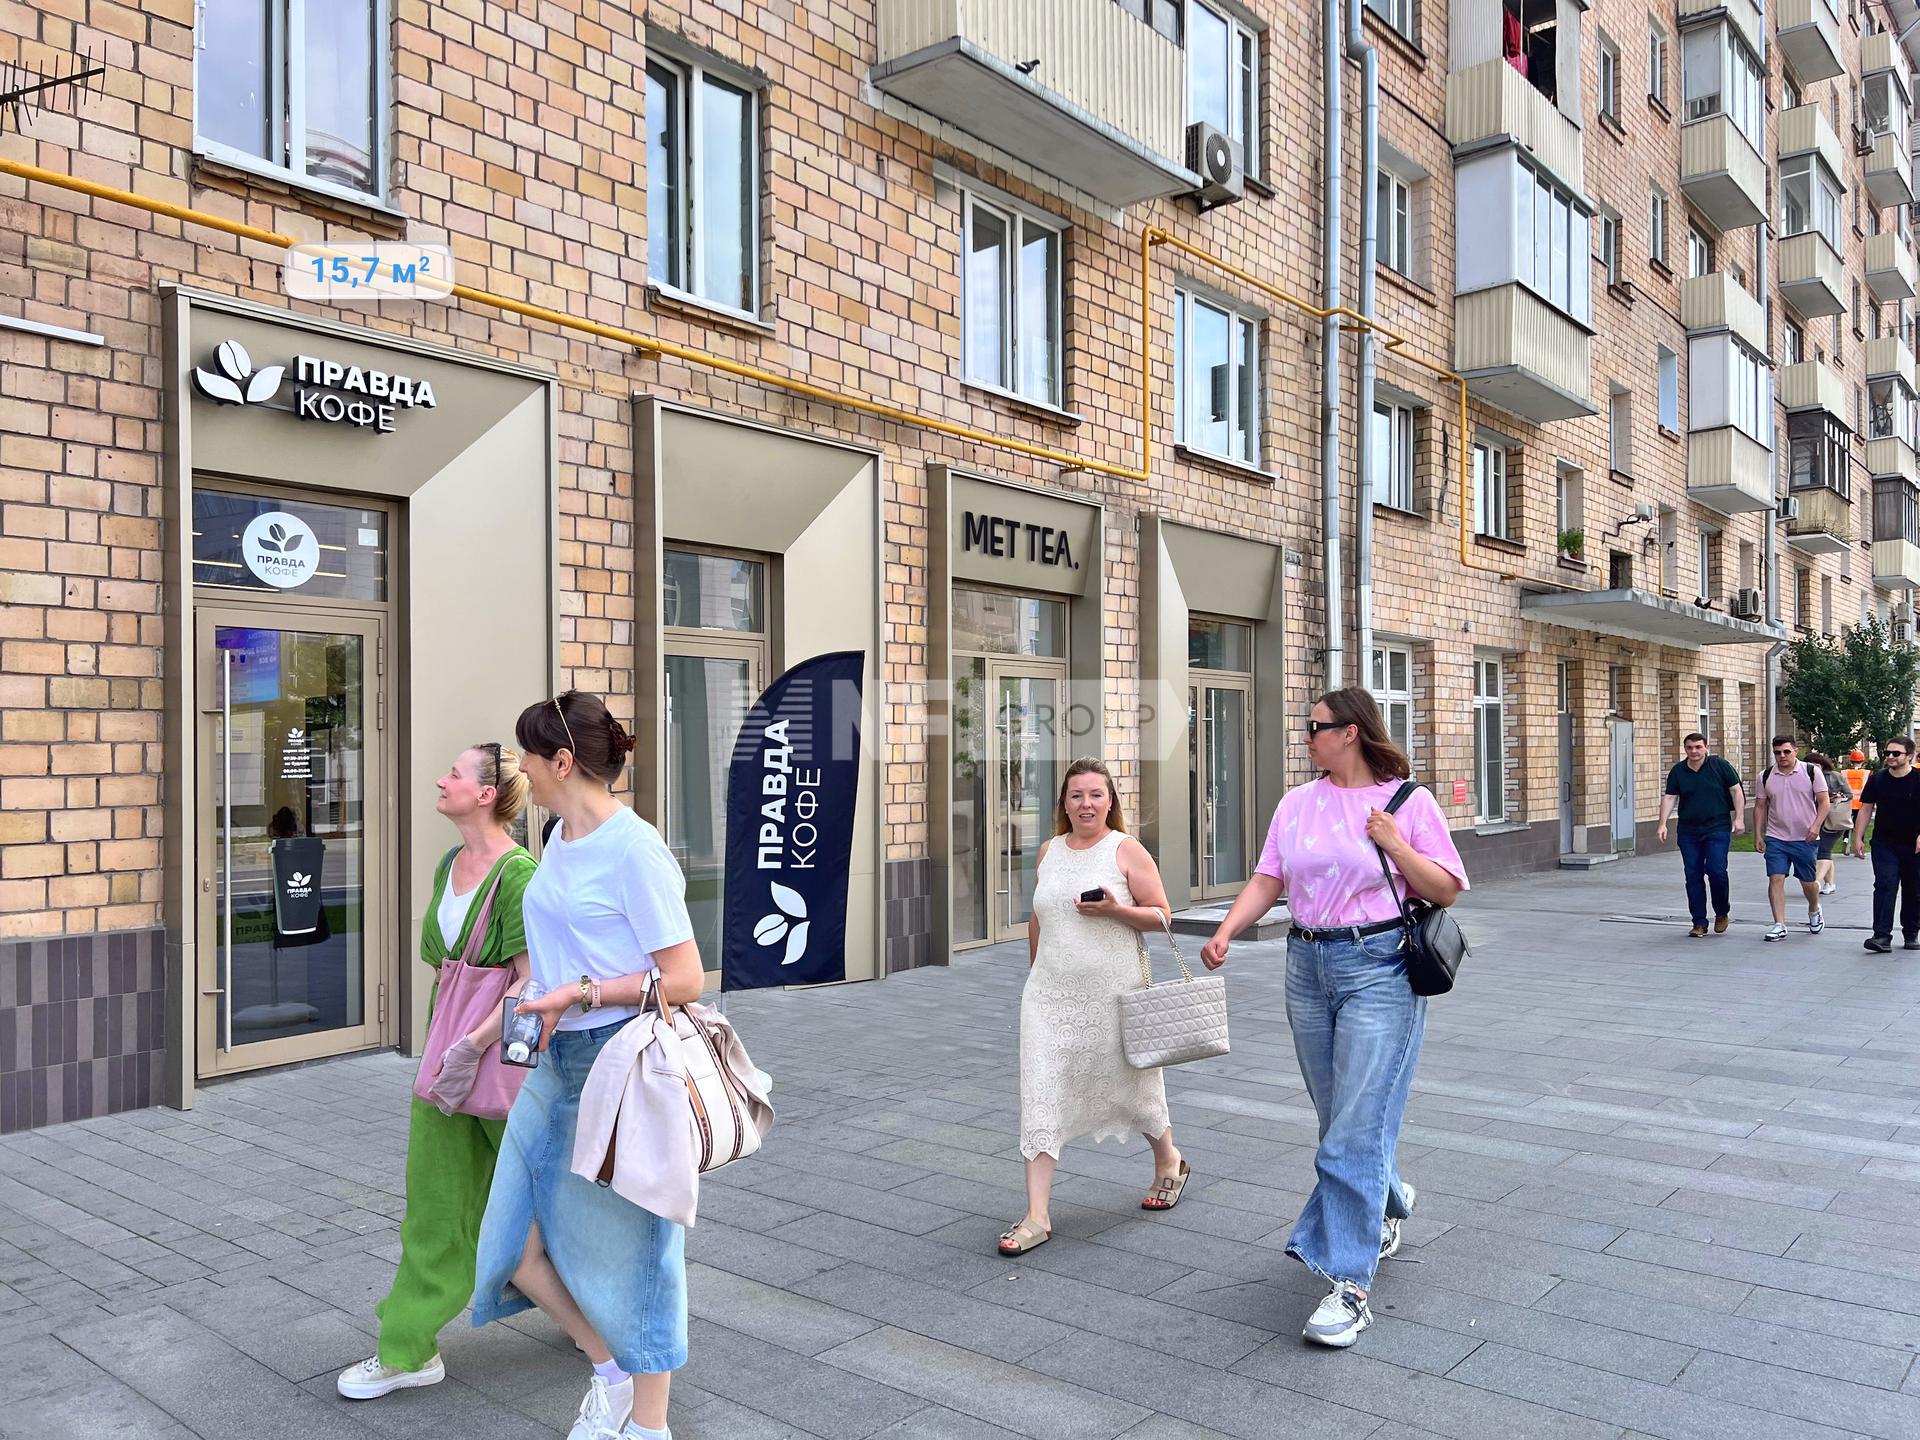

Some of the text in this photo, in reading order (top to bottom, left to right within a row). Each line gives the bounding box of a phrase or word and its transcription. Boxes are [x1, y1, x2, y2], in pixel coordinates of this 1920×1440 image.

[297, 355, 437, 408] ПРАВДА
[299, 389, 397, 432] КОФЕ
[257, 555, 305, 568] ПРАВДА
[964, 511, 1079, 570] MET TEA.
[265, 566, 299, 577] КОФЕ
[757, 719, 793, 869] ПРАВДА
[790, 767, 821, 869] КОФЕ
